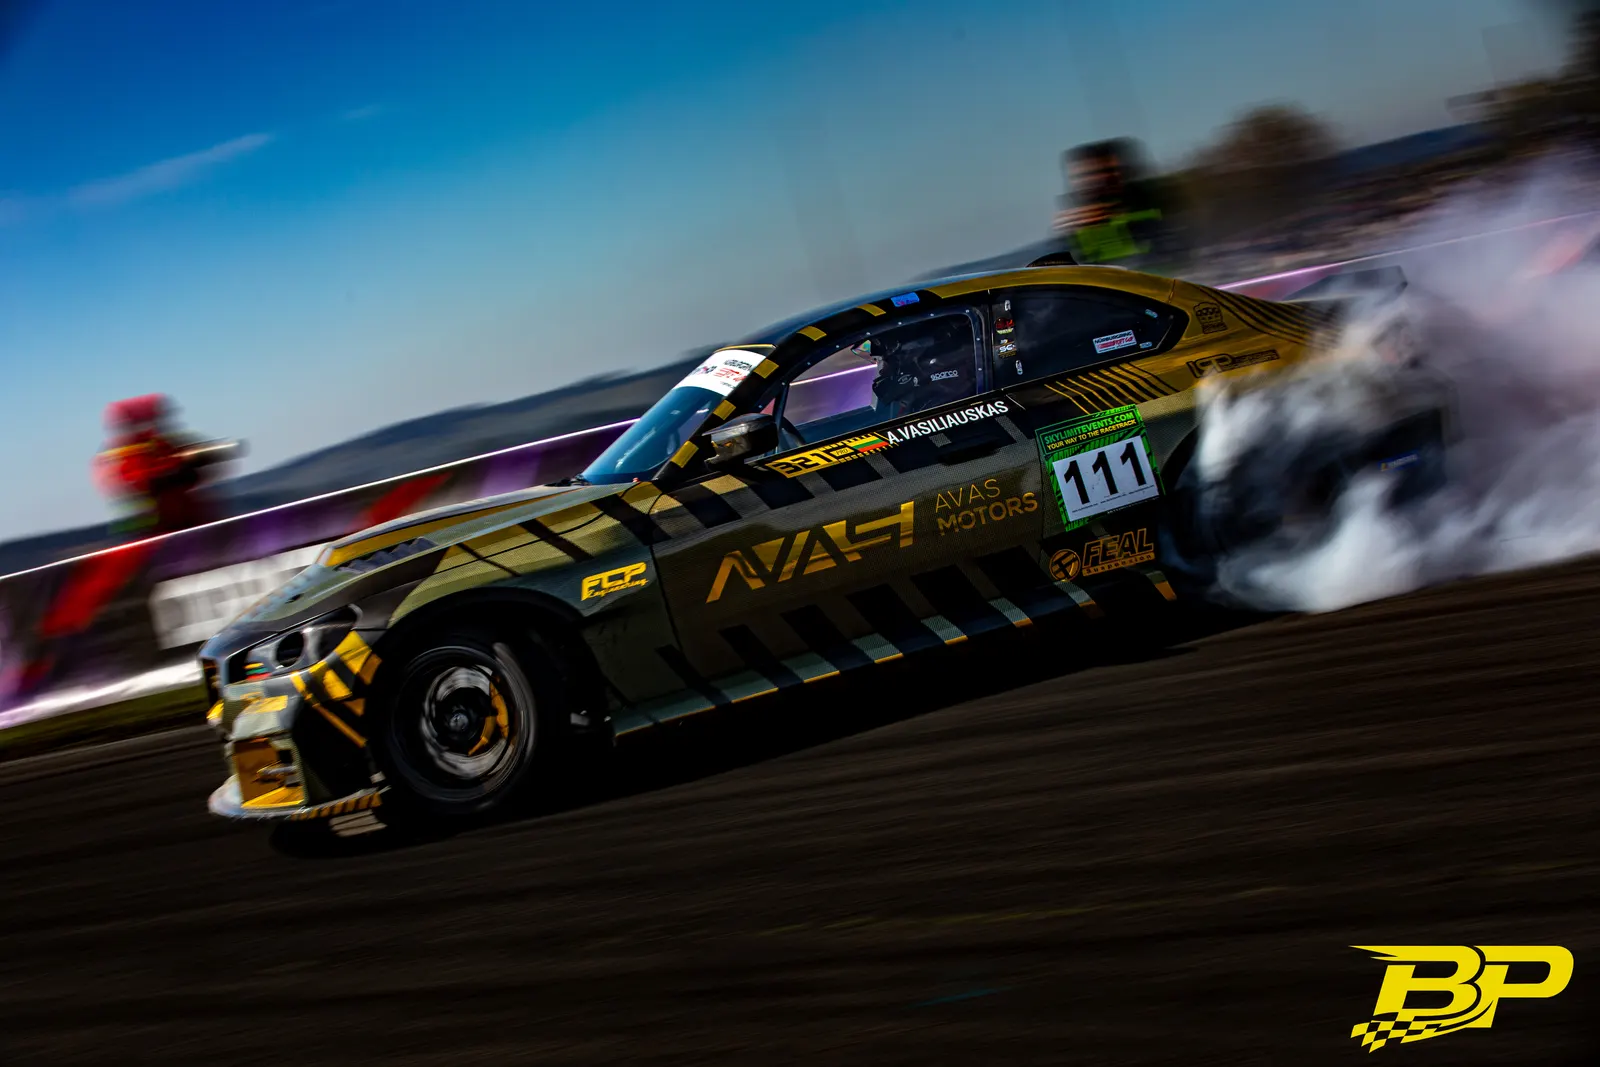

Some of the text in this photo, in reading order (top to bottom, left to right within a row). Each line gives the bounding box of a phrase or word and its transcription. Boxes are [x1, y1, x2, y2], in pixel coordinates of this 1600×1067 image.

[930, 370, 958, 381] sparco
[886, 401, 1009, 445] A.VASILIAUSKAS
[1044, 411, 1135, 444] SKYLIMITEVENTS.COM
[1047, 441, 1065, 451] YOUR
[1065, 437, 1078, 446] WAY
[1078, 434, 1087, 442] TO
[1100, 419, 1137, 435] RACETRACK
[1064, 442, 1147, 505] 111
[935, 478, 1001, 513] AVAS
[937, 491, 1039, 536] MOTORS
[1082, 528, 1155, 569] FEAL
[581, 561, 647, 601] FCP
